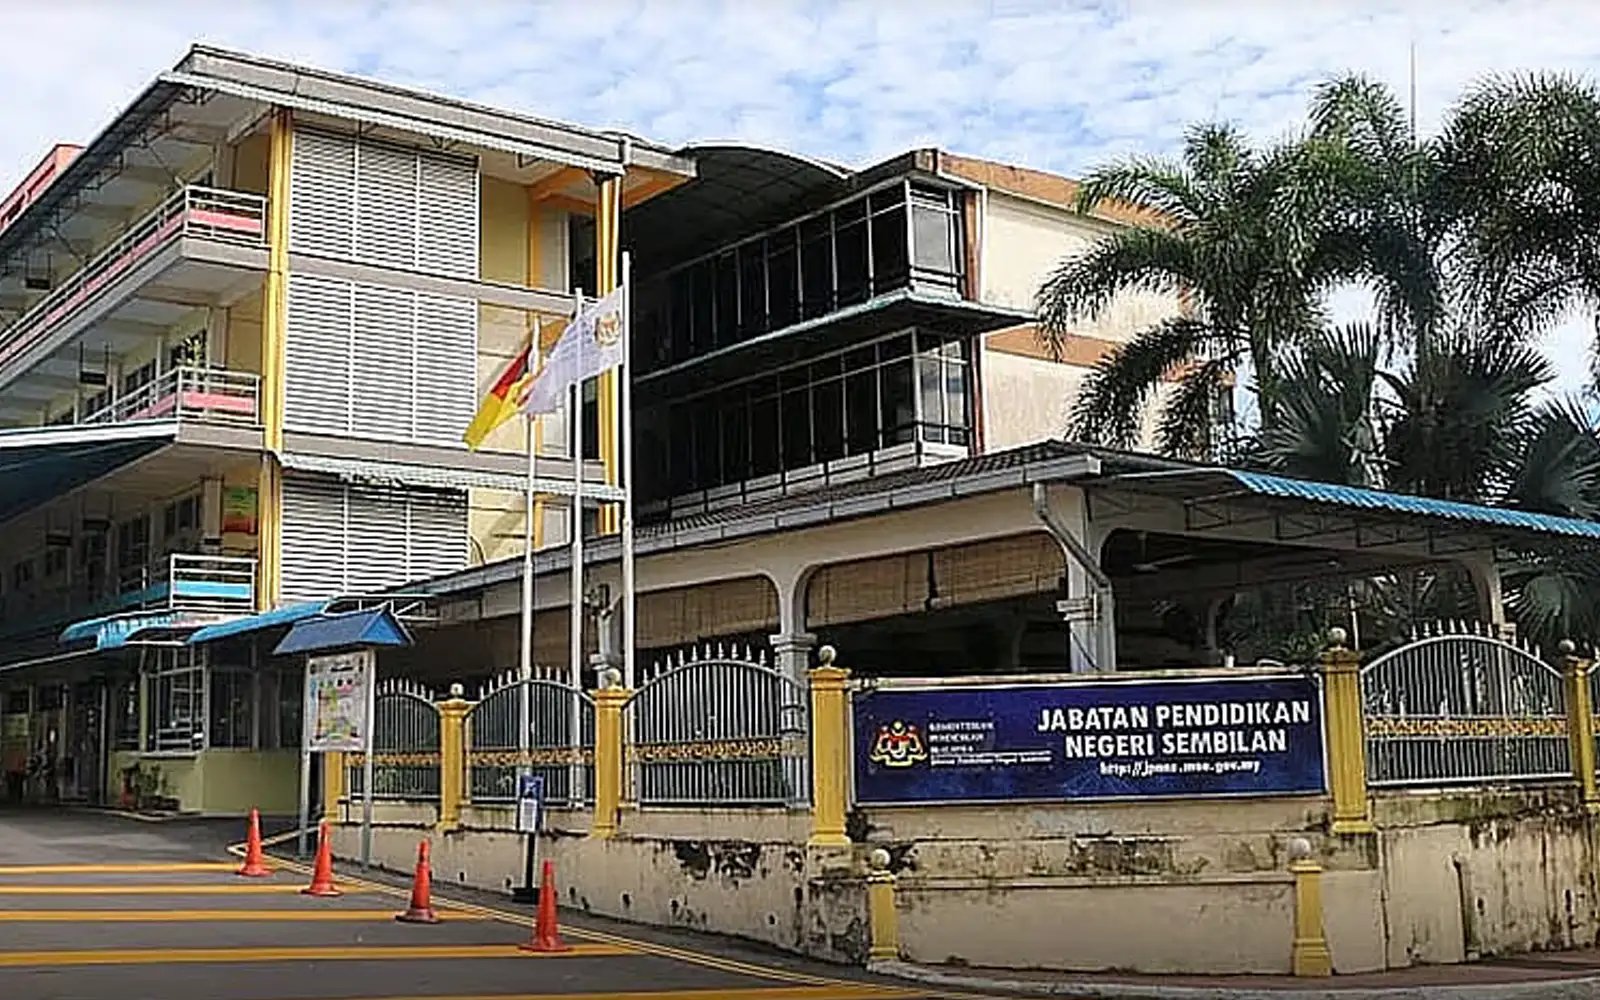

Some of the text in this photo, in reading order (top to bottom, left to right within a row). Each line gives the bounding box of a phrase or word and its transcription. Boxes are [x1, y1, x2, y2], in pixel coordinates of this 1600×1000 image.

[1037, 700, 1310, 731] JABATAN PENDIDIKAN
[1065, 729, 1287, 758] NEGERI SEMBILAN
